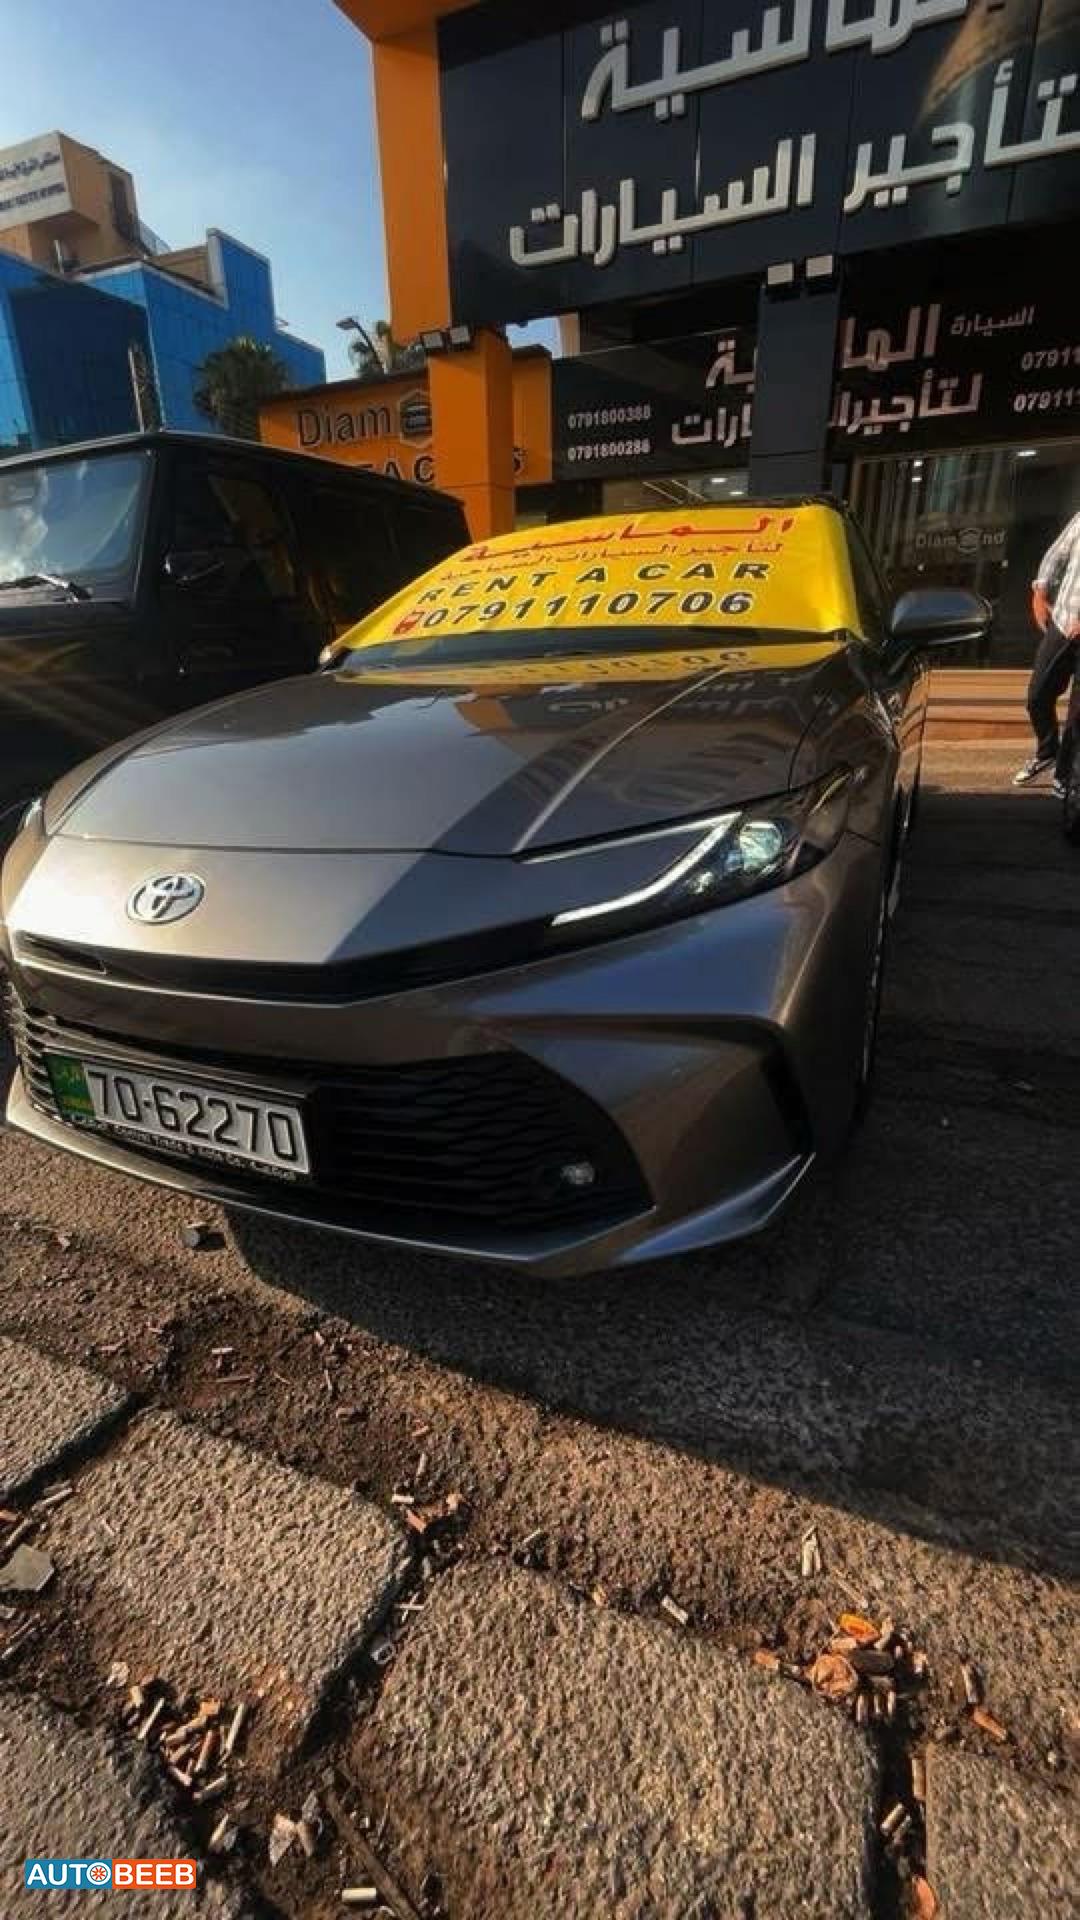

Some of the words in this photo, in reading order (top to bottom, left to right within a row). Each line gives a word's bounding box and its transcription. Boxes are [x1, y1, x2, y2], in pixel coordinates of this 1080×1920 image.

[581, 0, 968, 120] ماسية
[844, 60, 1080, 213] تأجير
[509, 133, 816, 266] السيارات
[421, 570, 558, 603] RENT
[576, 566, 607, 584] A
[636, 562, 771, 581] CAR
[423, 591, 754, 628] 0791110706
[88, 1071, 298, 1162] 70-62270
